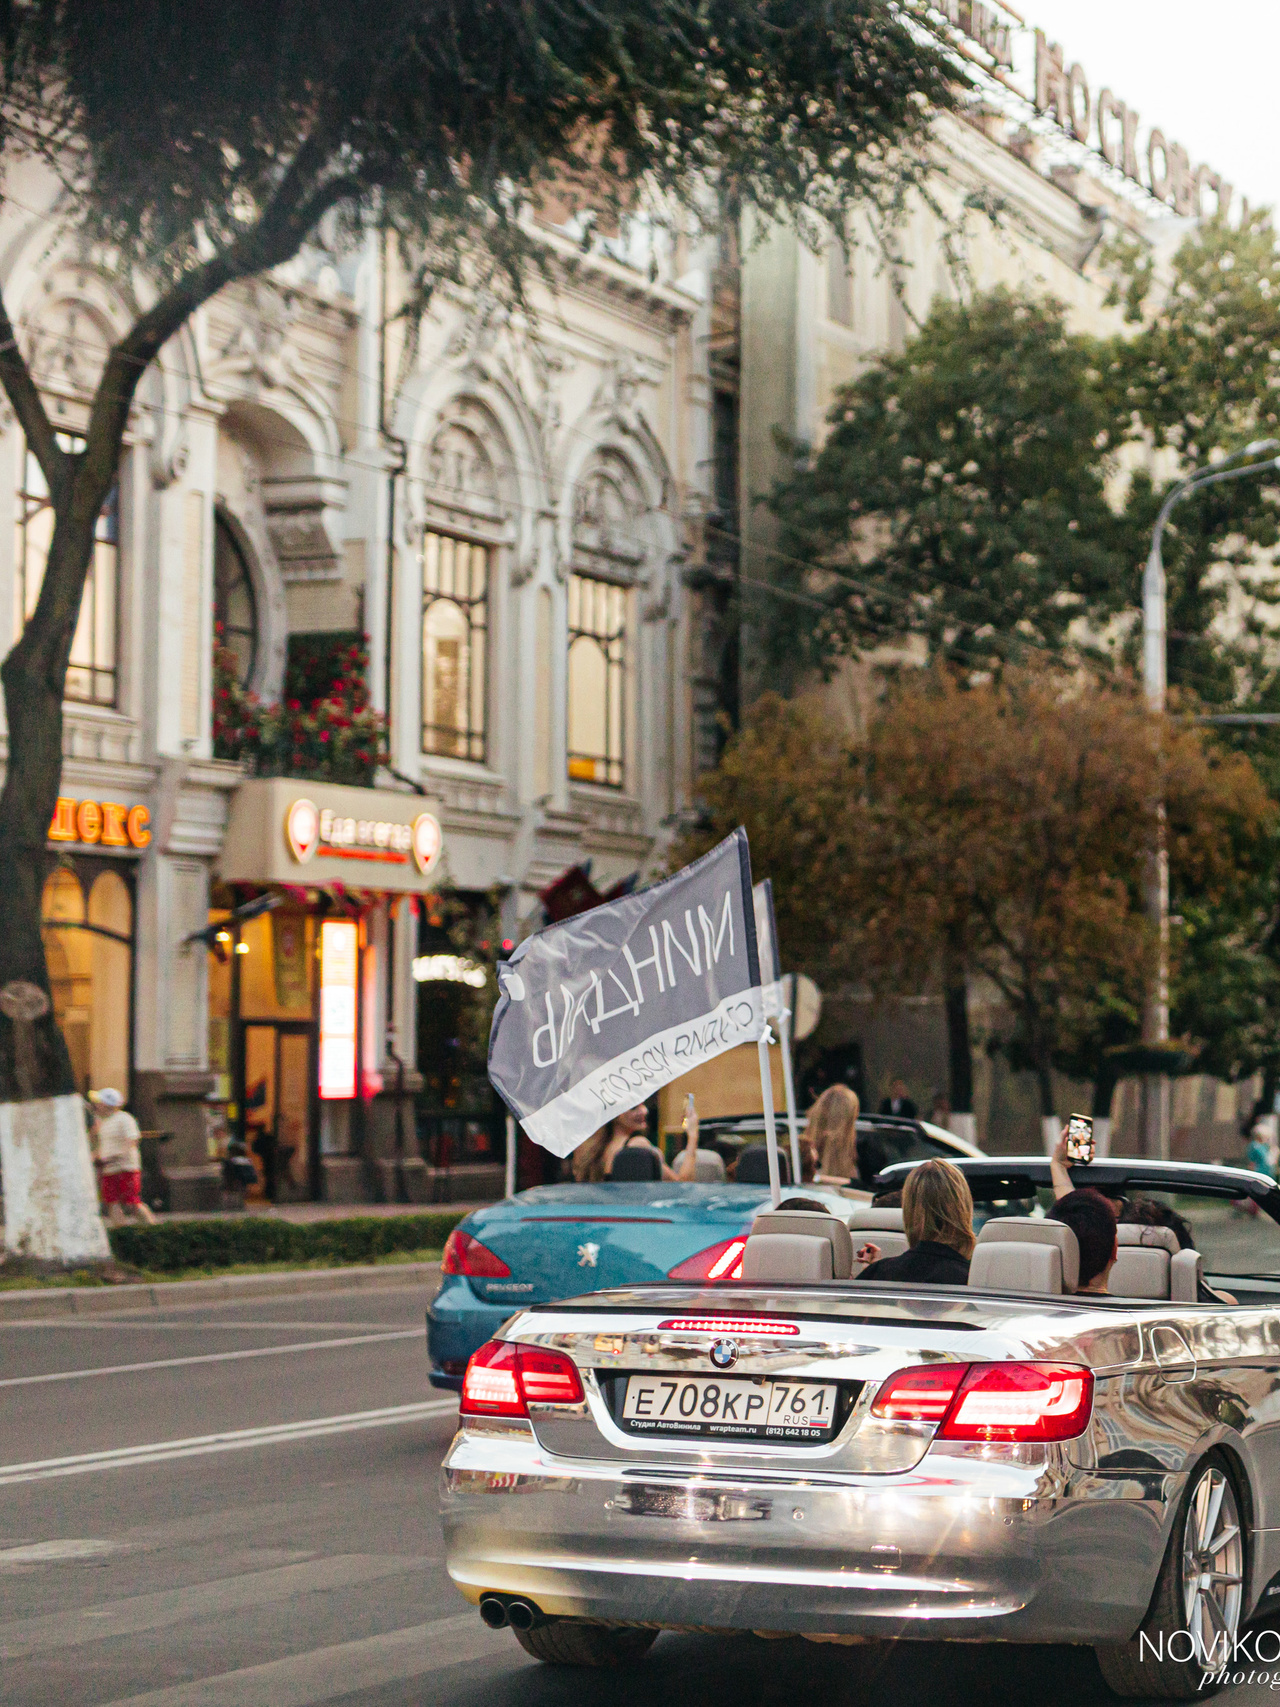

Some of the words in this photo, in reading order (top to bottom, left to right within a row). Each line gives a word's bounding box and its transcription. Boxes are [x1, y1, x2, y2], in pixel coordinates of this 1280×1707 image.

[774, 1387, 825, 1415] 761
[630, 1419, 656, 1429] Студия
[709, 1425, 757, 1434] wrapteam.ru
[765, 1427, 784, 1437] (812)
[785, 1428, 799, 1436] 642
[810, 1429, 821, 1437] 05
[783, 1415, 809, 1426] RUS
